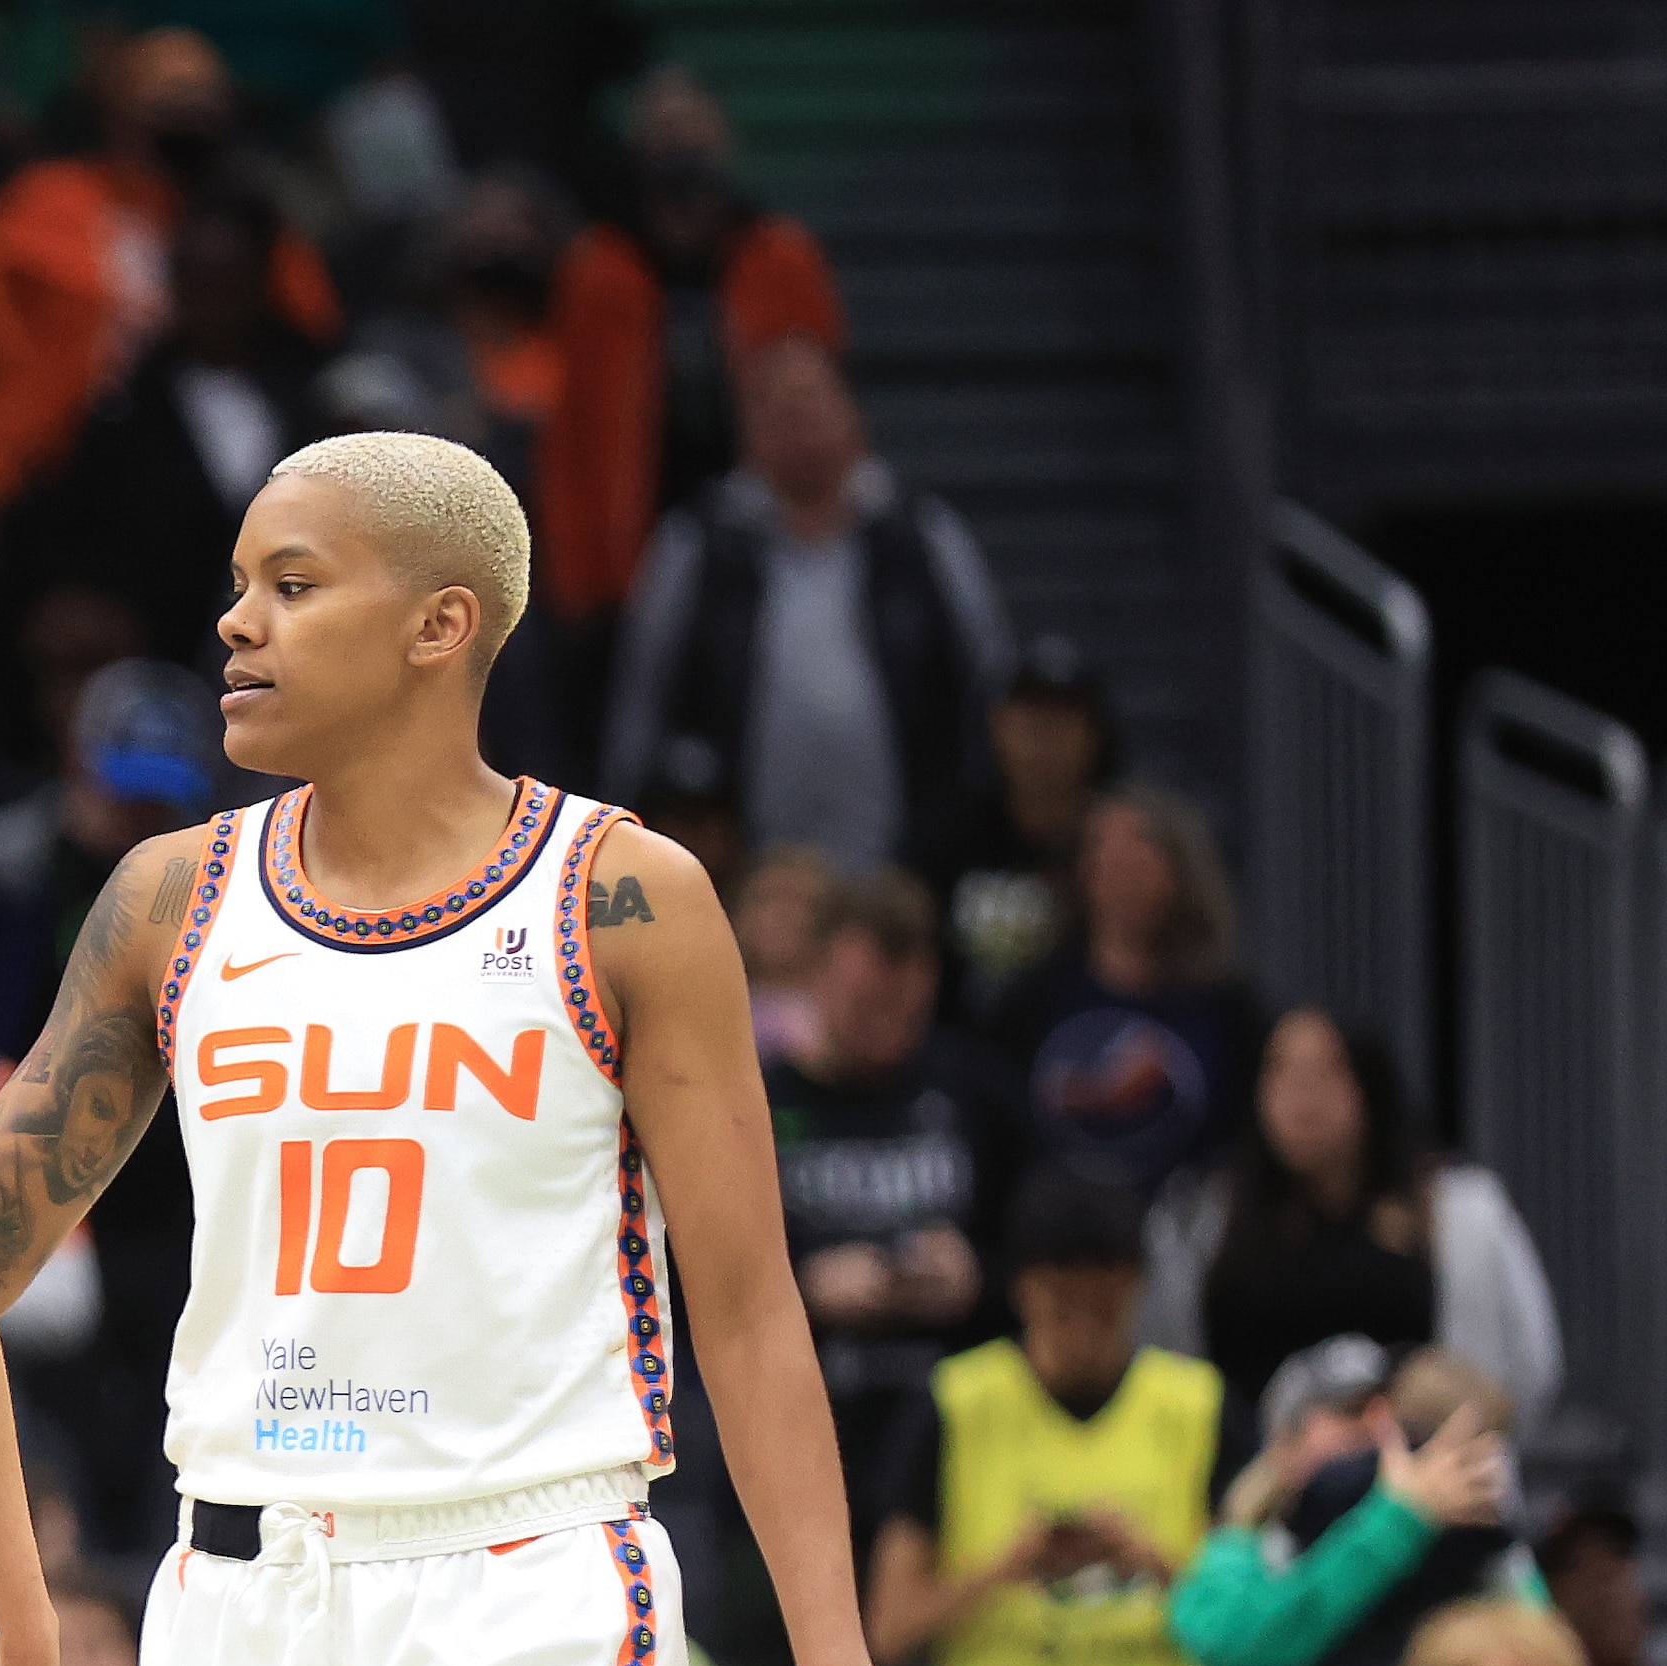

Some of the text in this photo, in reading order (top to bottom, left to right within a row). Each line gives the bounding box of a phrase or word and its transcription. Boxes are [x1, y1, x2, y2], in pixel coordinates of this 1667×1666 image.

[481, 953, 533, 970] Post
[197, 1022, 547, 1121] SUN
[275, 1138, 425, 1295] 10
[262, 1338, 317, 1370] Yale
[256, 1378, 429, 1414] NewHaven
[255, 1419, 366, 1451] Health
